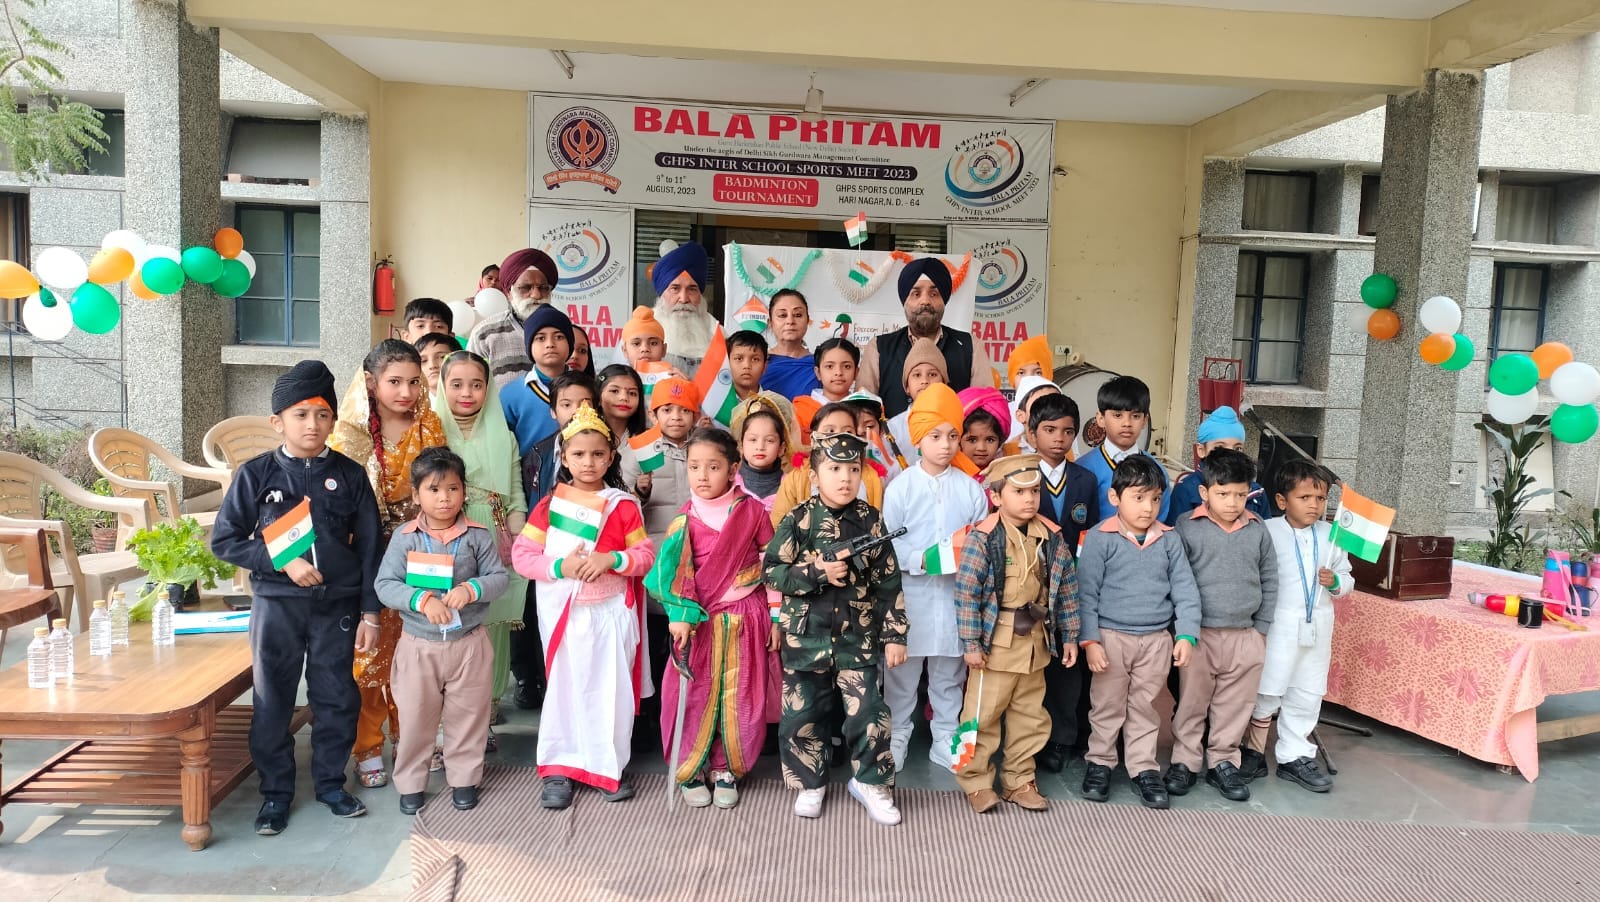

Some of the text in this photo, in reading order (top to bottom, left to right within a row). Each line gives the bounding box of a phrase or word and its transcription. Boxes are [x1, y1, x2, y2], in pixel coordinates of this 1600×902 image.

[578, 110, 614, 136] MANAGEMENT
[634, 106, 942, 149] BALA PRITAM
[684, 145, 705, 153] Under
[718, 147, 734, 156] aegis
[744, 148, 762, 156] Delhi
[763, 150, 778, 158] Sikh
[779, 150, 811, 158] Gurdwara
[813, 152, 854, 162] Management
[662, 155, 911, 179] GHPS INTER SCHOOL SPORTS MEET 2023
[666, 176, 673, 184] to
[677, 186, 696, 195] 2023
[724, 176, 808, 190] BADMINTON
[836, 184, 925, 196] GHPS SPORTS COMPLEX
[992, 190, 1010, 201] BALA
[1010, 171, 1034, 194] PRITAM
[718, 190, 814, 205] TOURNAMENT
[838, 196, 858, 204] HARI
[910, 198, 920, 206] 64
[945, 177, 1040, 216] GHPS INTER SCHOOL MEET 2023
[579, 276, 598, 289] BALA
[598, 260, 620, 282] PRITAM
[998, 295, 1015, 306] BALA
[1016, 277, 1037, 298] PRITAM
[567, 304, 612, 326] ALA
[972, 321, 1028, 341] BALA
